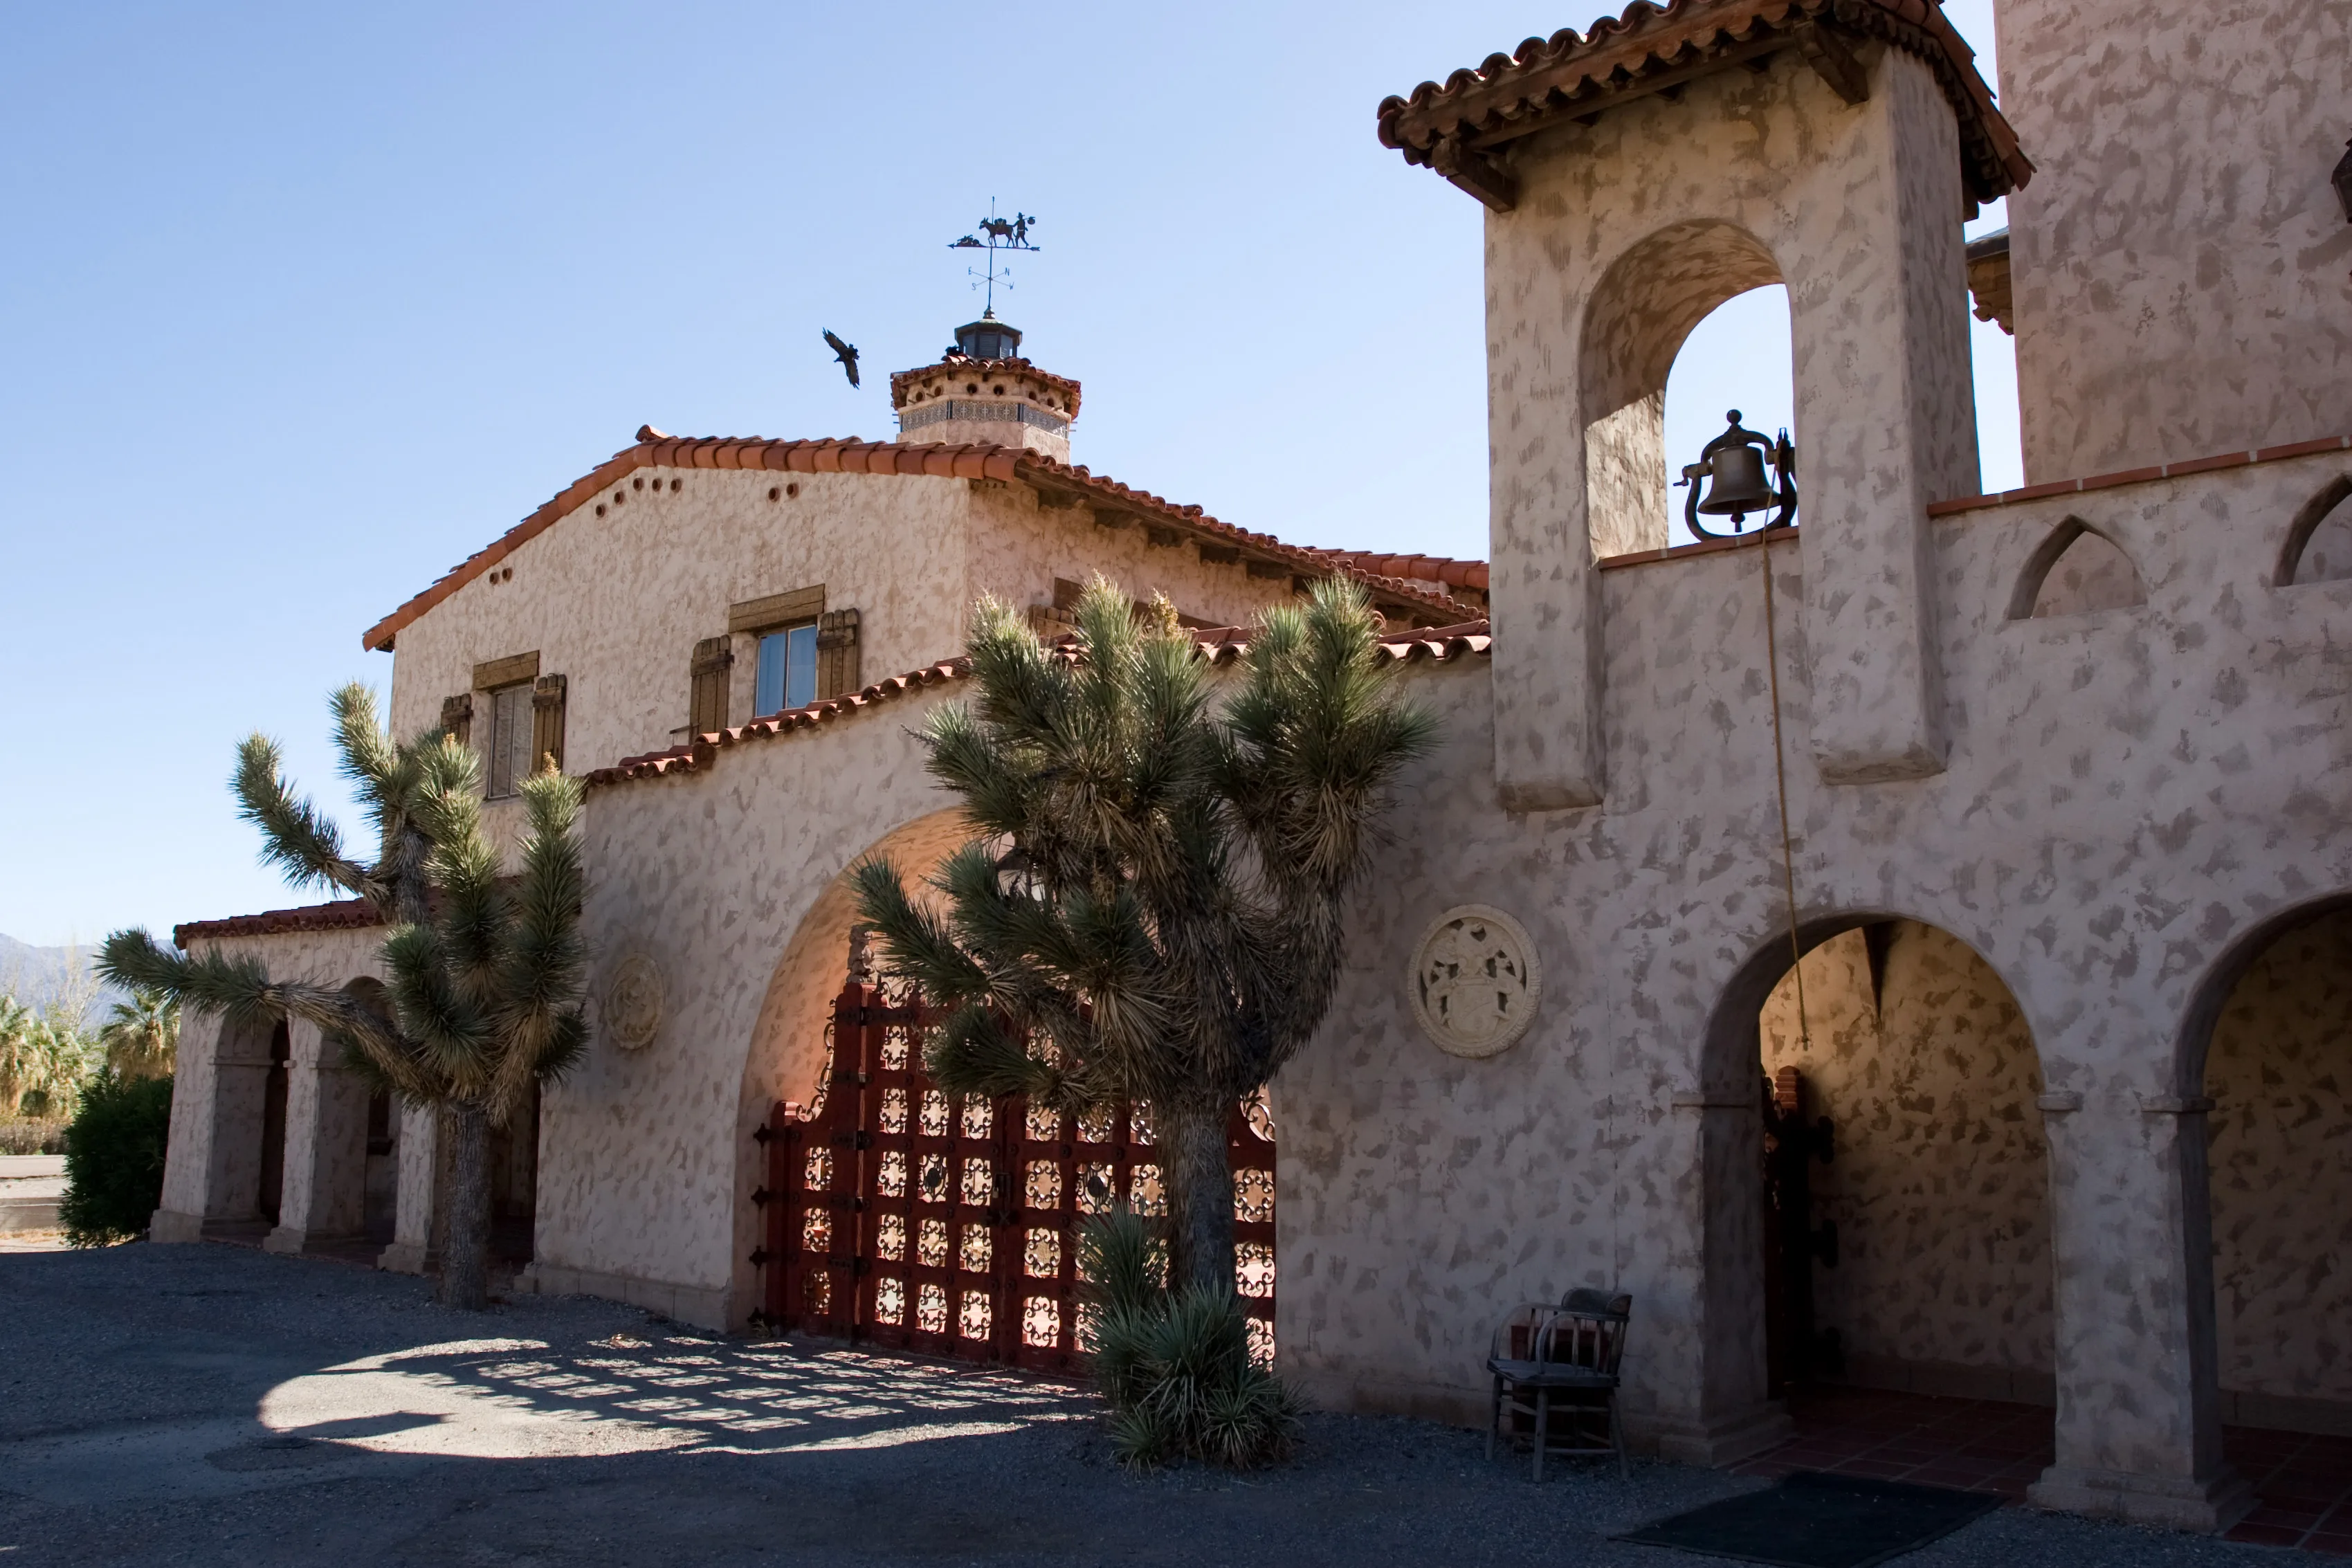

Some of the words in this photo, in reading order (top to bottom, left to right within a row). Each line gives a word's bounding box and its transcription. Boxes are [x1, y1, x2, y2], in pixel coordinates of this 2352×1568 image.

[968, 266, 972, 275] E
[1005, 267, 1010, 276] N
[972, 282, 976, 291] S
[1010, 282, 1014, 290] W
